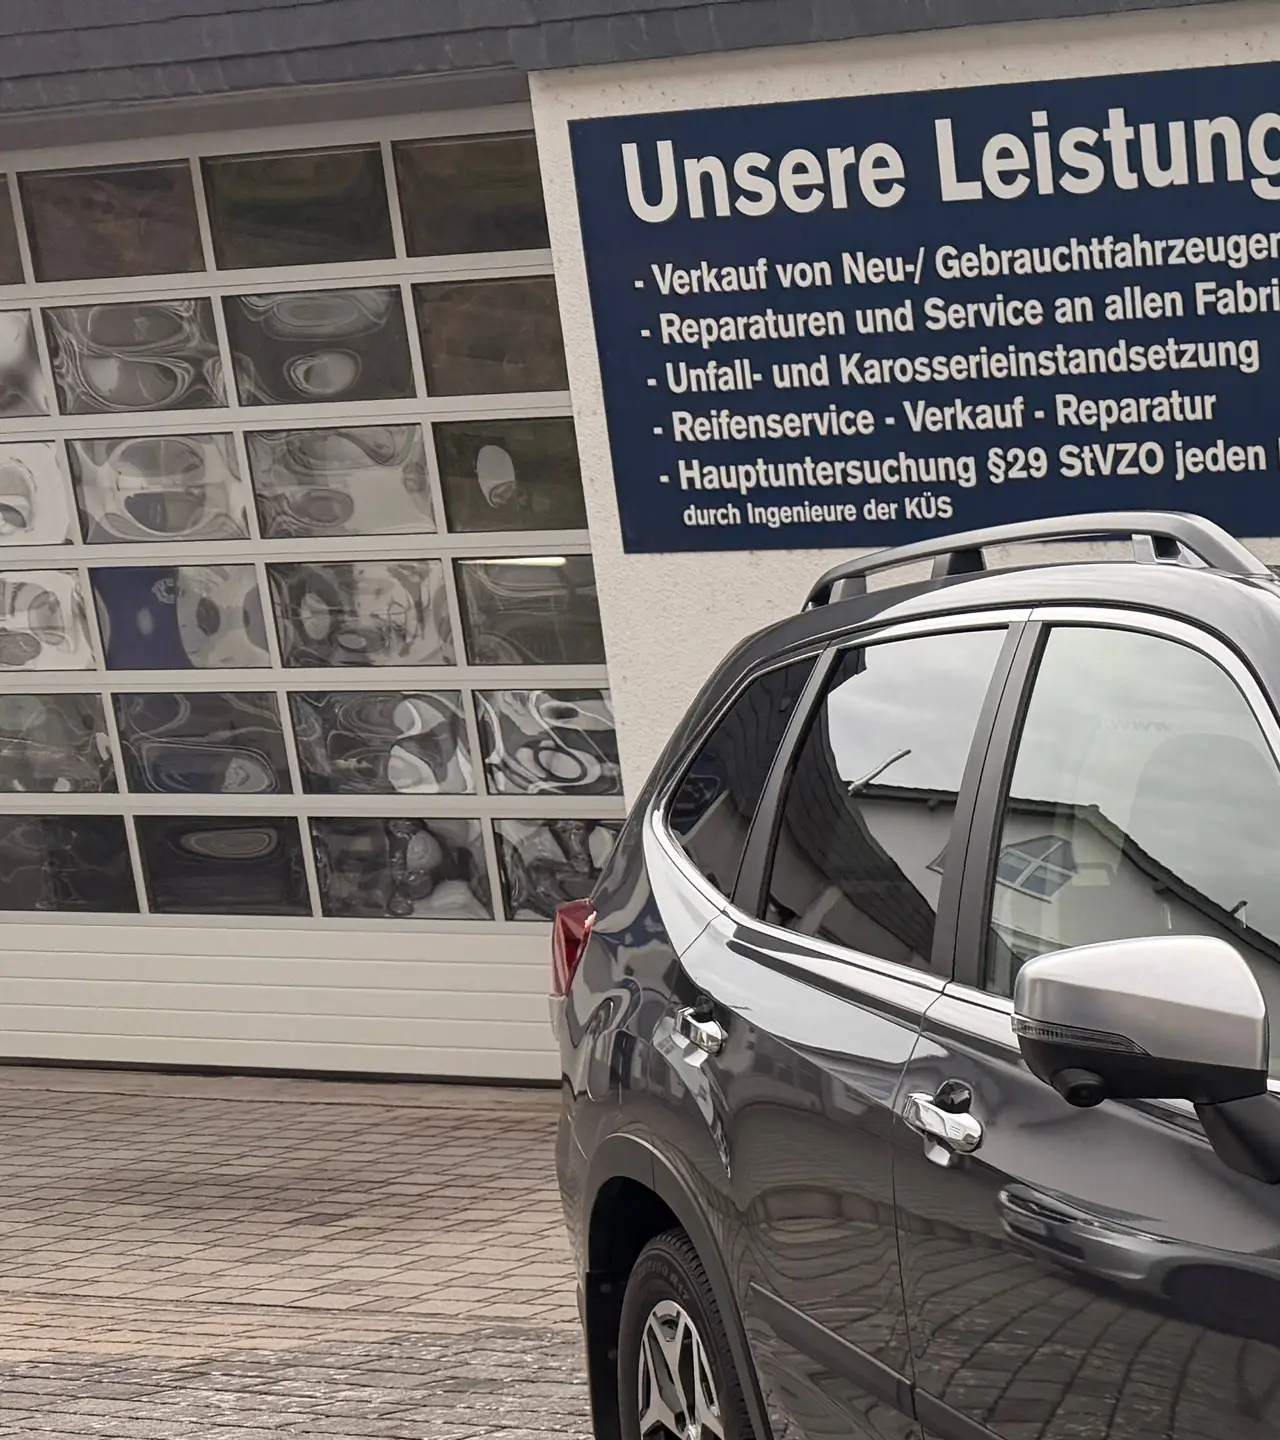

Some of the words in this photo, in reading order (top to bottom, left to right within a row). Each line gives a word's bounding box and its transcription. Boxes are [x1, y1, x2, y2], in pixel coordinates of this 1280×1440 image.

[621, 139, 906, 223] Unsere
[651, 257, 768, 295] Verkauf
[776, 261, 833, 288] von
[841, 247, 925, 285] Neu-/
[660, 308, 846, 350] Reparaturen
[855, 299, 914, 334] und
[924, 293, 1044, 331] Service
[1054, 296, 1094, 324] an
[1104, 285, 1184, 321] allen
[665, 358, 763, 394] Unfall-
[772, 354, 830, 389] und
[839, 337, 1260, 386] Karosserieinstandsetzung
[671, 403, 875, 442] Reifenservice
[902, 395, 1025, 432] Verkauf
[1055, 389, 1217, 432] Reparatur
[678, 451, 977, 496] Hauptuntersuchung
[987, 446, 1048, 485] §29
[1059, 441, 1164, 478] StVZO
[1175, 439, 1267, 482] jeden
[683, 503, 742, 527] durch
[746, 500, 857, 529] Ingenieure
[863, 498, 899, 521] der
[904, 491, 954, 520] KÜS
